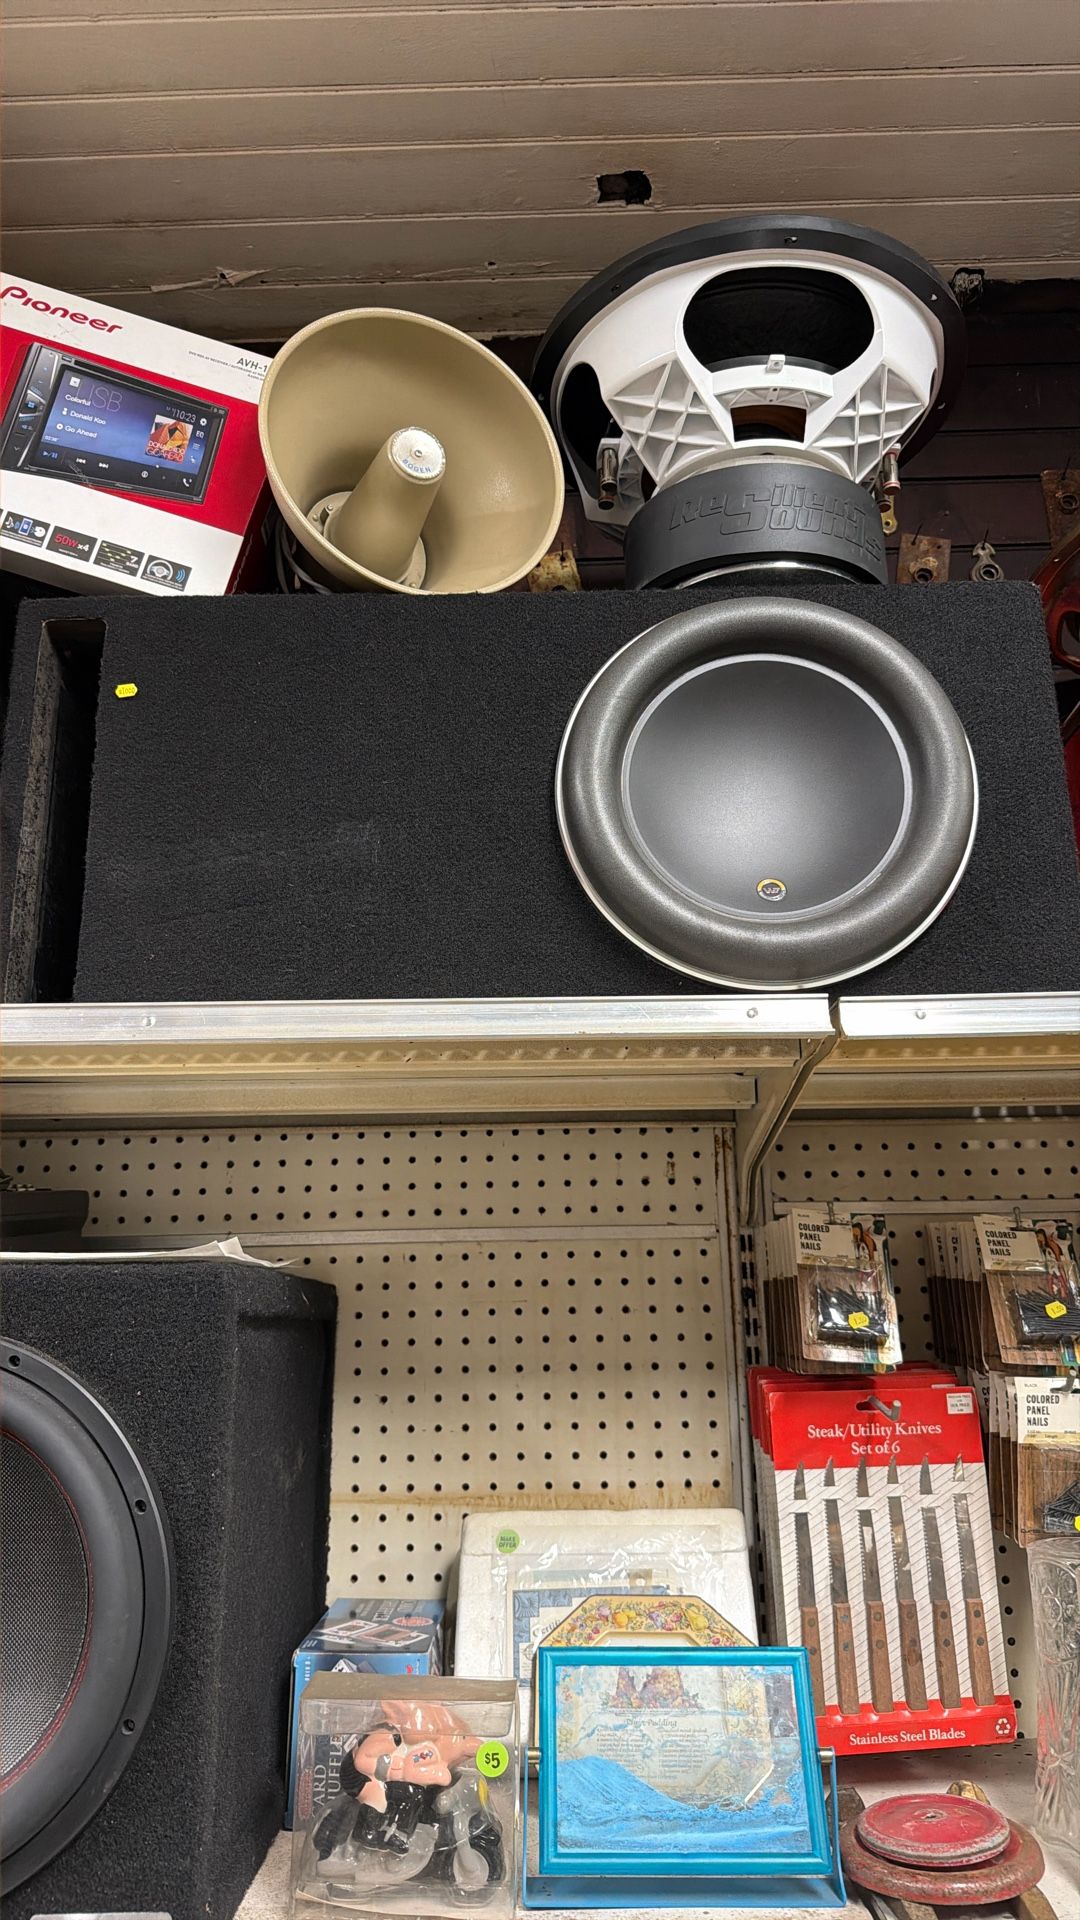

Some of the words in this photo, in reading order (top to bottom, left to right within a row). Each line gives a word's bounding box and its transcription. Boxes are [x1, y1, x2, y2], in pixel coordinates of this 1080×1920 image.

[0, 286, 123, 333] Pioneer
[237, 357, 268, 373] AVH-1
[65, 394, 92, 407] Colorful
[70, 410, 93, 422] Donald
[64, 425, 75, 433] Go
[76, 428, 98, 438] Ahead
[195, 430, 205, 439] EQ
[798, 1222, 830, 1233] COLORED
[799, 1231, 822, 1242] PANEL
[984, 1230, 1017, 1239] COLORED
[800, 1241, 822, 1251] NAILS
[987, 1238, 1011, 1248] PANEL
[989, 1247, 1011, 1256] NAILS
[1026, 1394, 1060, 1404] COLORED
[1026, 1405, 1050, 1415] PANEL
[1026, 1416, 1049, 1426] NAILS
[807, 1422, 892, 1440] Steak/Utility
[895, 1421, 942, 1435] Knives
[851, 1441, 872, 1455] Set
[874, 1440, 890, 1454] of
[891, 1440, 901, 1454] 6
[849, 1732, 899, 1745] Stainless
[899, 1729, 927, 1742] Steel
[928, 1727, 966, 1741] Blades
[484, 1751, 500, 1769] $5
[312, 1764, 327, 1813] ARD
